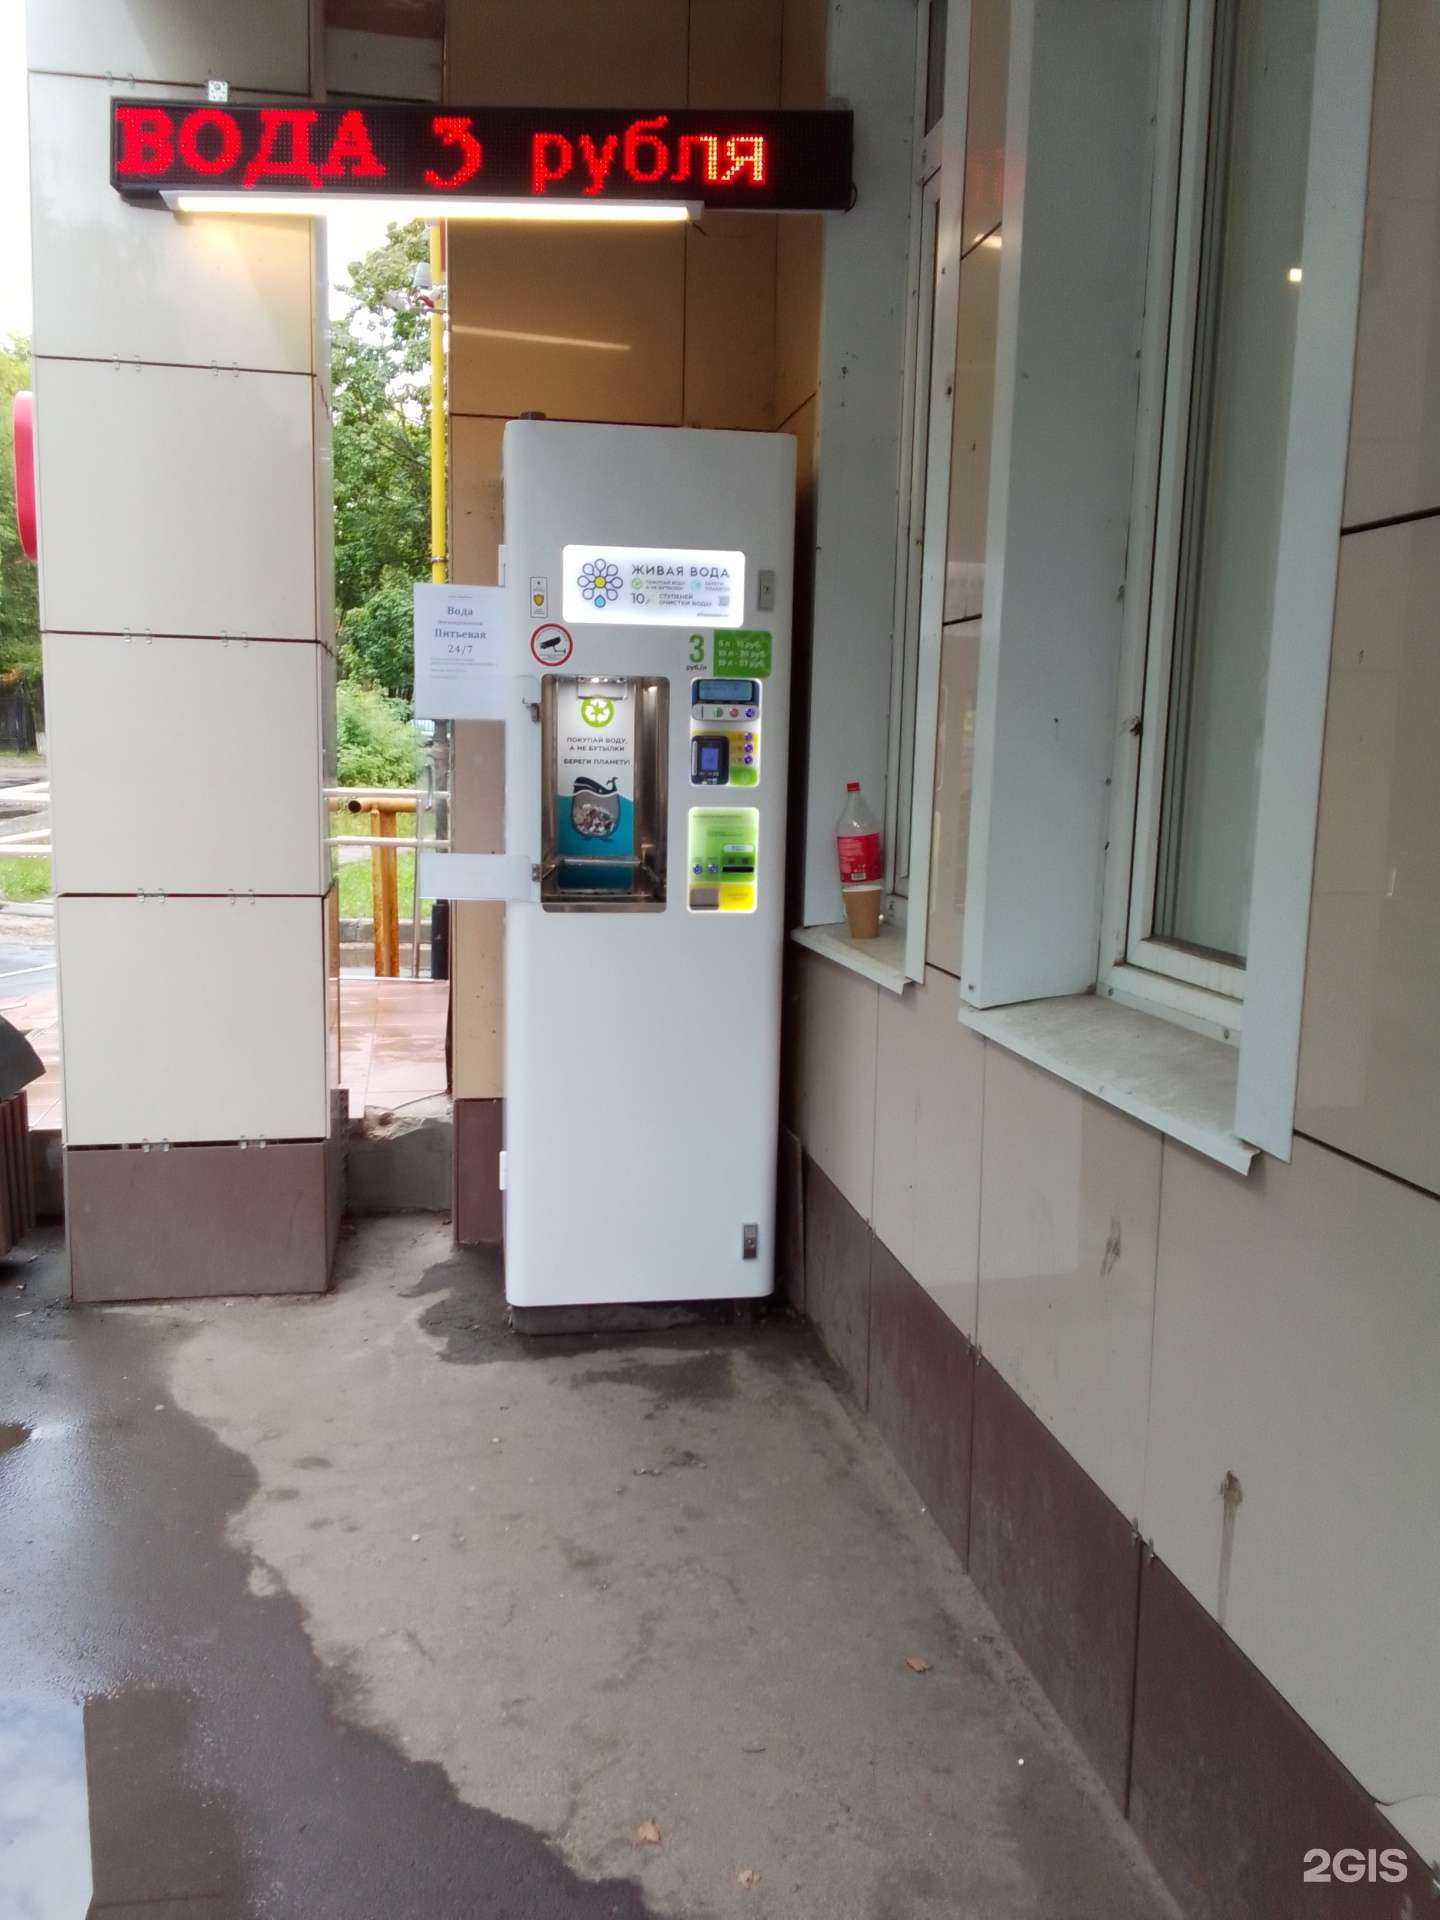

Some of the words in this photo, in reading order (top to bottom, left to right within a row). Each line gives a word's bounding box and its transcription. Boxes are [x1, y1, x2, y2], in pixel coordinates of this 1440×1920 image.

[115, 107, 386, 189] ВОДА
[424, 116, 482, 189] 3
[531, 115, 770, 195] рубля
[631, 564, 684, 577] ЖИВАЯ
[690, 566, 730, 578] ВОДА
[447, 606, 474, 617] Вода
[434, 628, 488, 640] Питьевая
[447, 644, 473, 656] 24/7
[689, 633, 705, 663] 3
